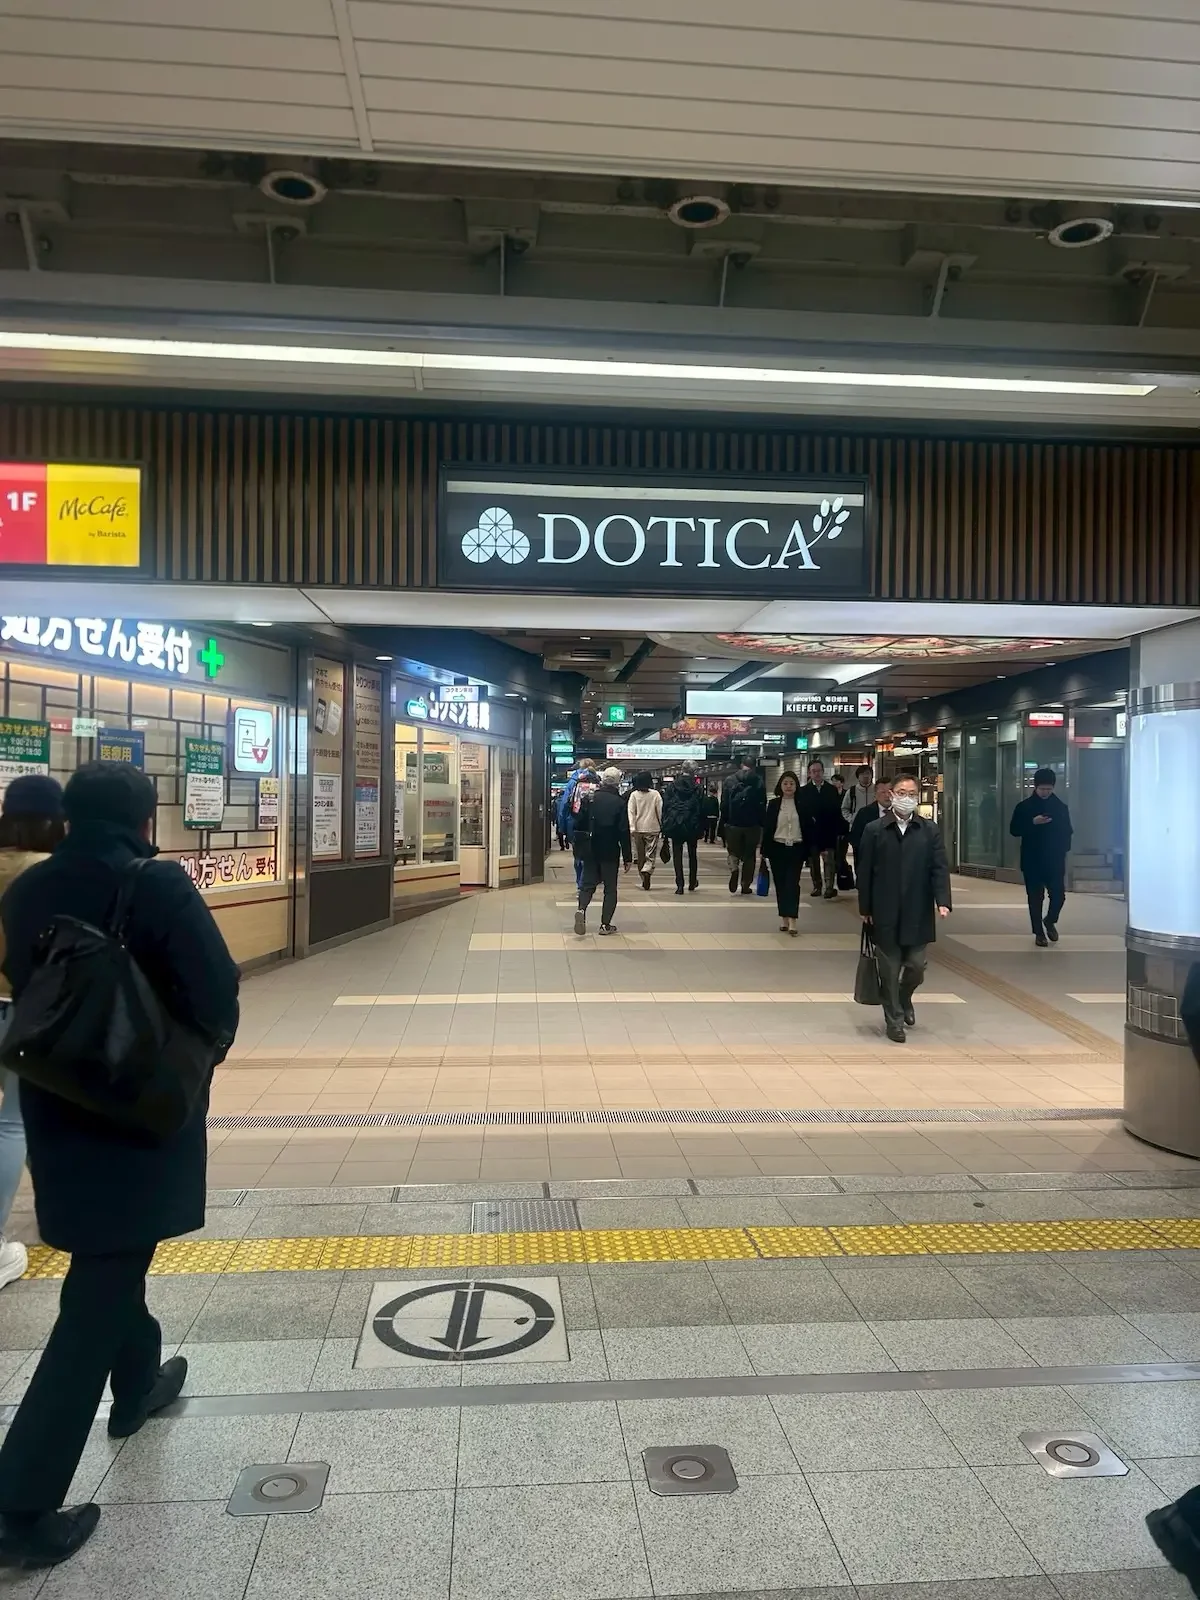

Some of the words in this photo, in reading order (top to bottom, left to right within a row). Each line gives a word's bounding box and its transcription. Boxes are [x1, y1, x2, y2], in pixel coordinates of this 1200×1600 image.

[7, 491, 37, 512] 1F
[59, 496, 126, 522] McCafé
[97, 530, 126, 538] Barista
[537, 512, 821, 570] DOTICA
[0, 615, 192, 674] 処方せん受付
[786, 704, 818, 712] KIEFEL
[820, 705, 855, 713] COFFEE
[180, 852, 253, 889] 処方せん
